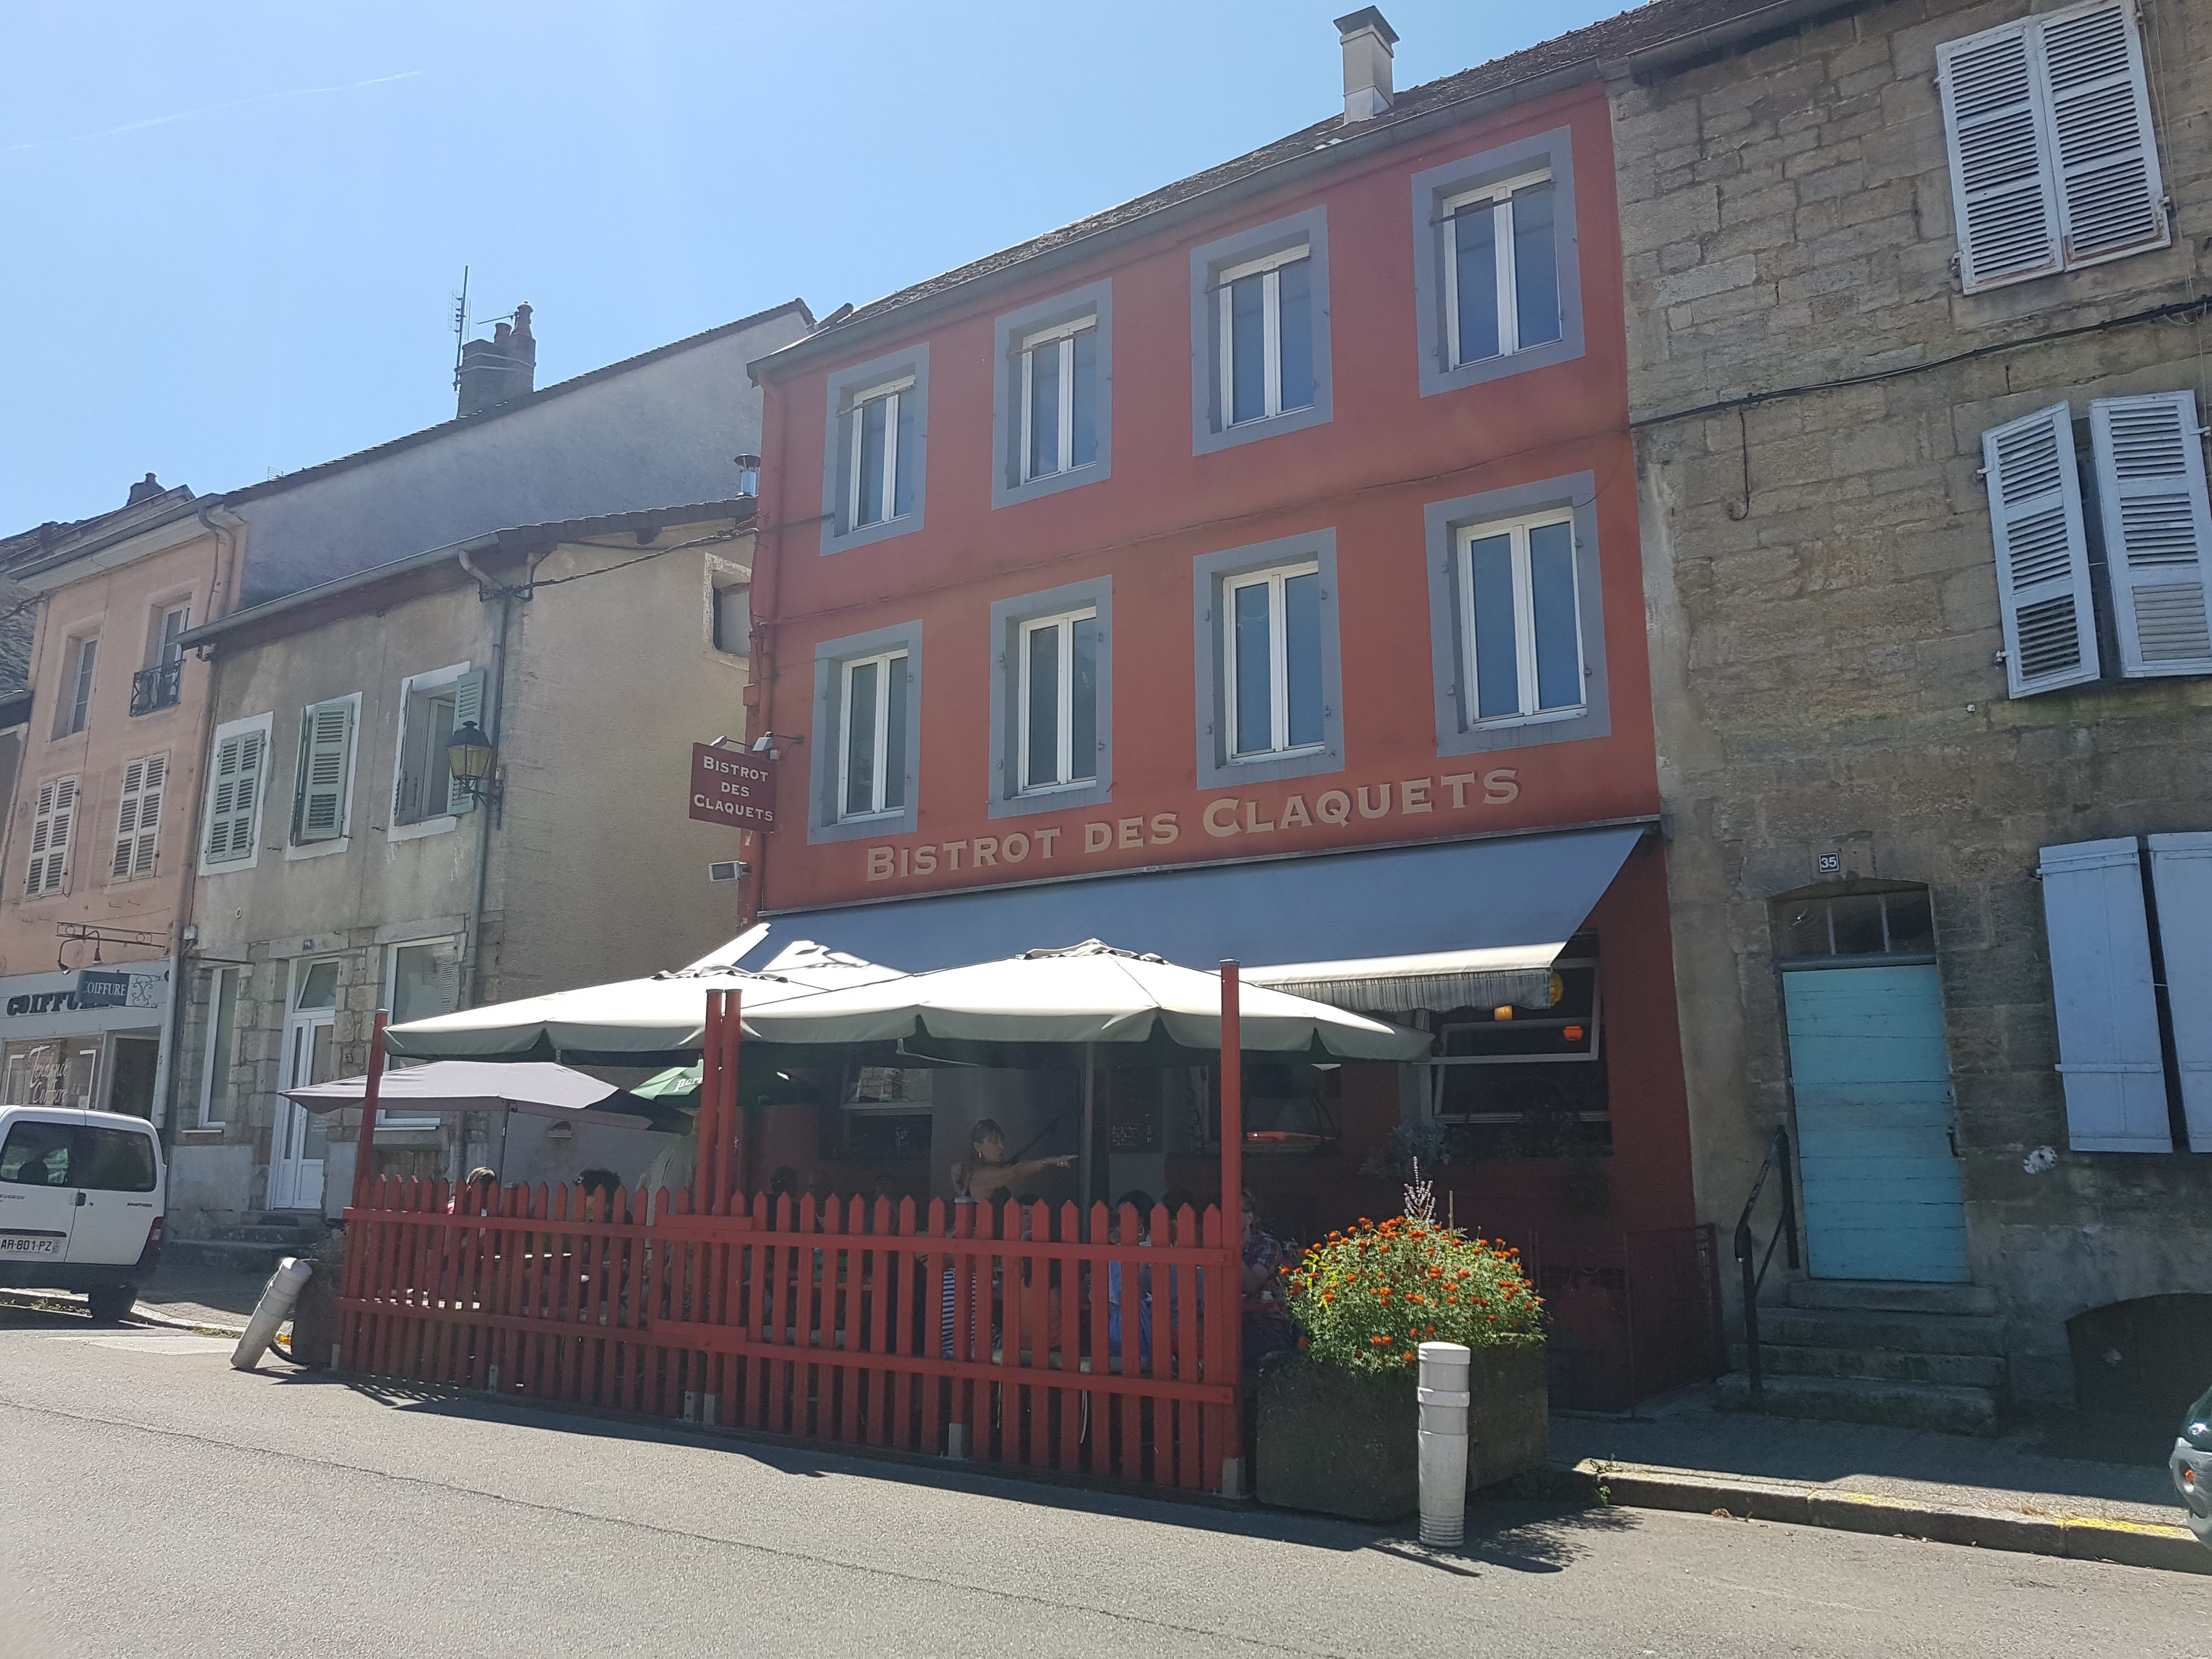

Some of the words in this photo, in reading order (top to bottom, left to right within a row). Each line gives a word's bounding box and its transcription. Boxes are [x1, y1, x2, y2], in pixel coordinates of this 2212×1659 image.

[703, 755, 768, 782] BISTROT
[721, 782, 749, 798] DES
[694, 794, 773, 822] CLAQUETS
[866, 827, 1060, 882] BISTROT
[1084, 813, 1180, 853] DES
[1203, 769, 1520, 838] CLAQUETS
[1821, 856, 1837, 868] 35
[7, 991, 109, 1015] COIFFU
[1, 1239, 53, 1251] AR-801-PZ
